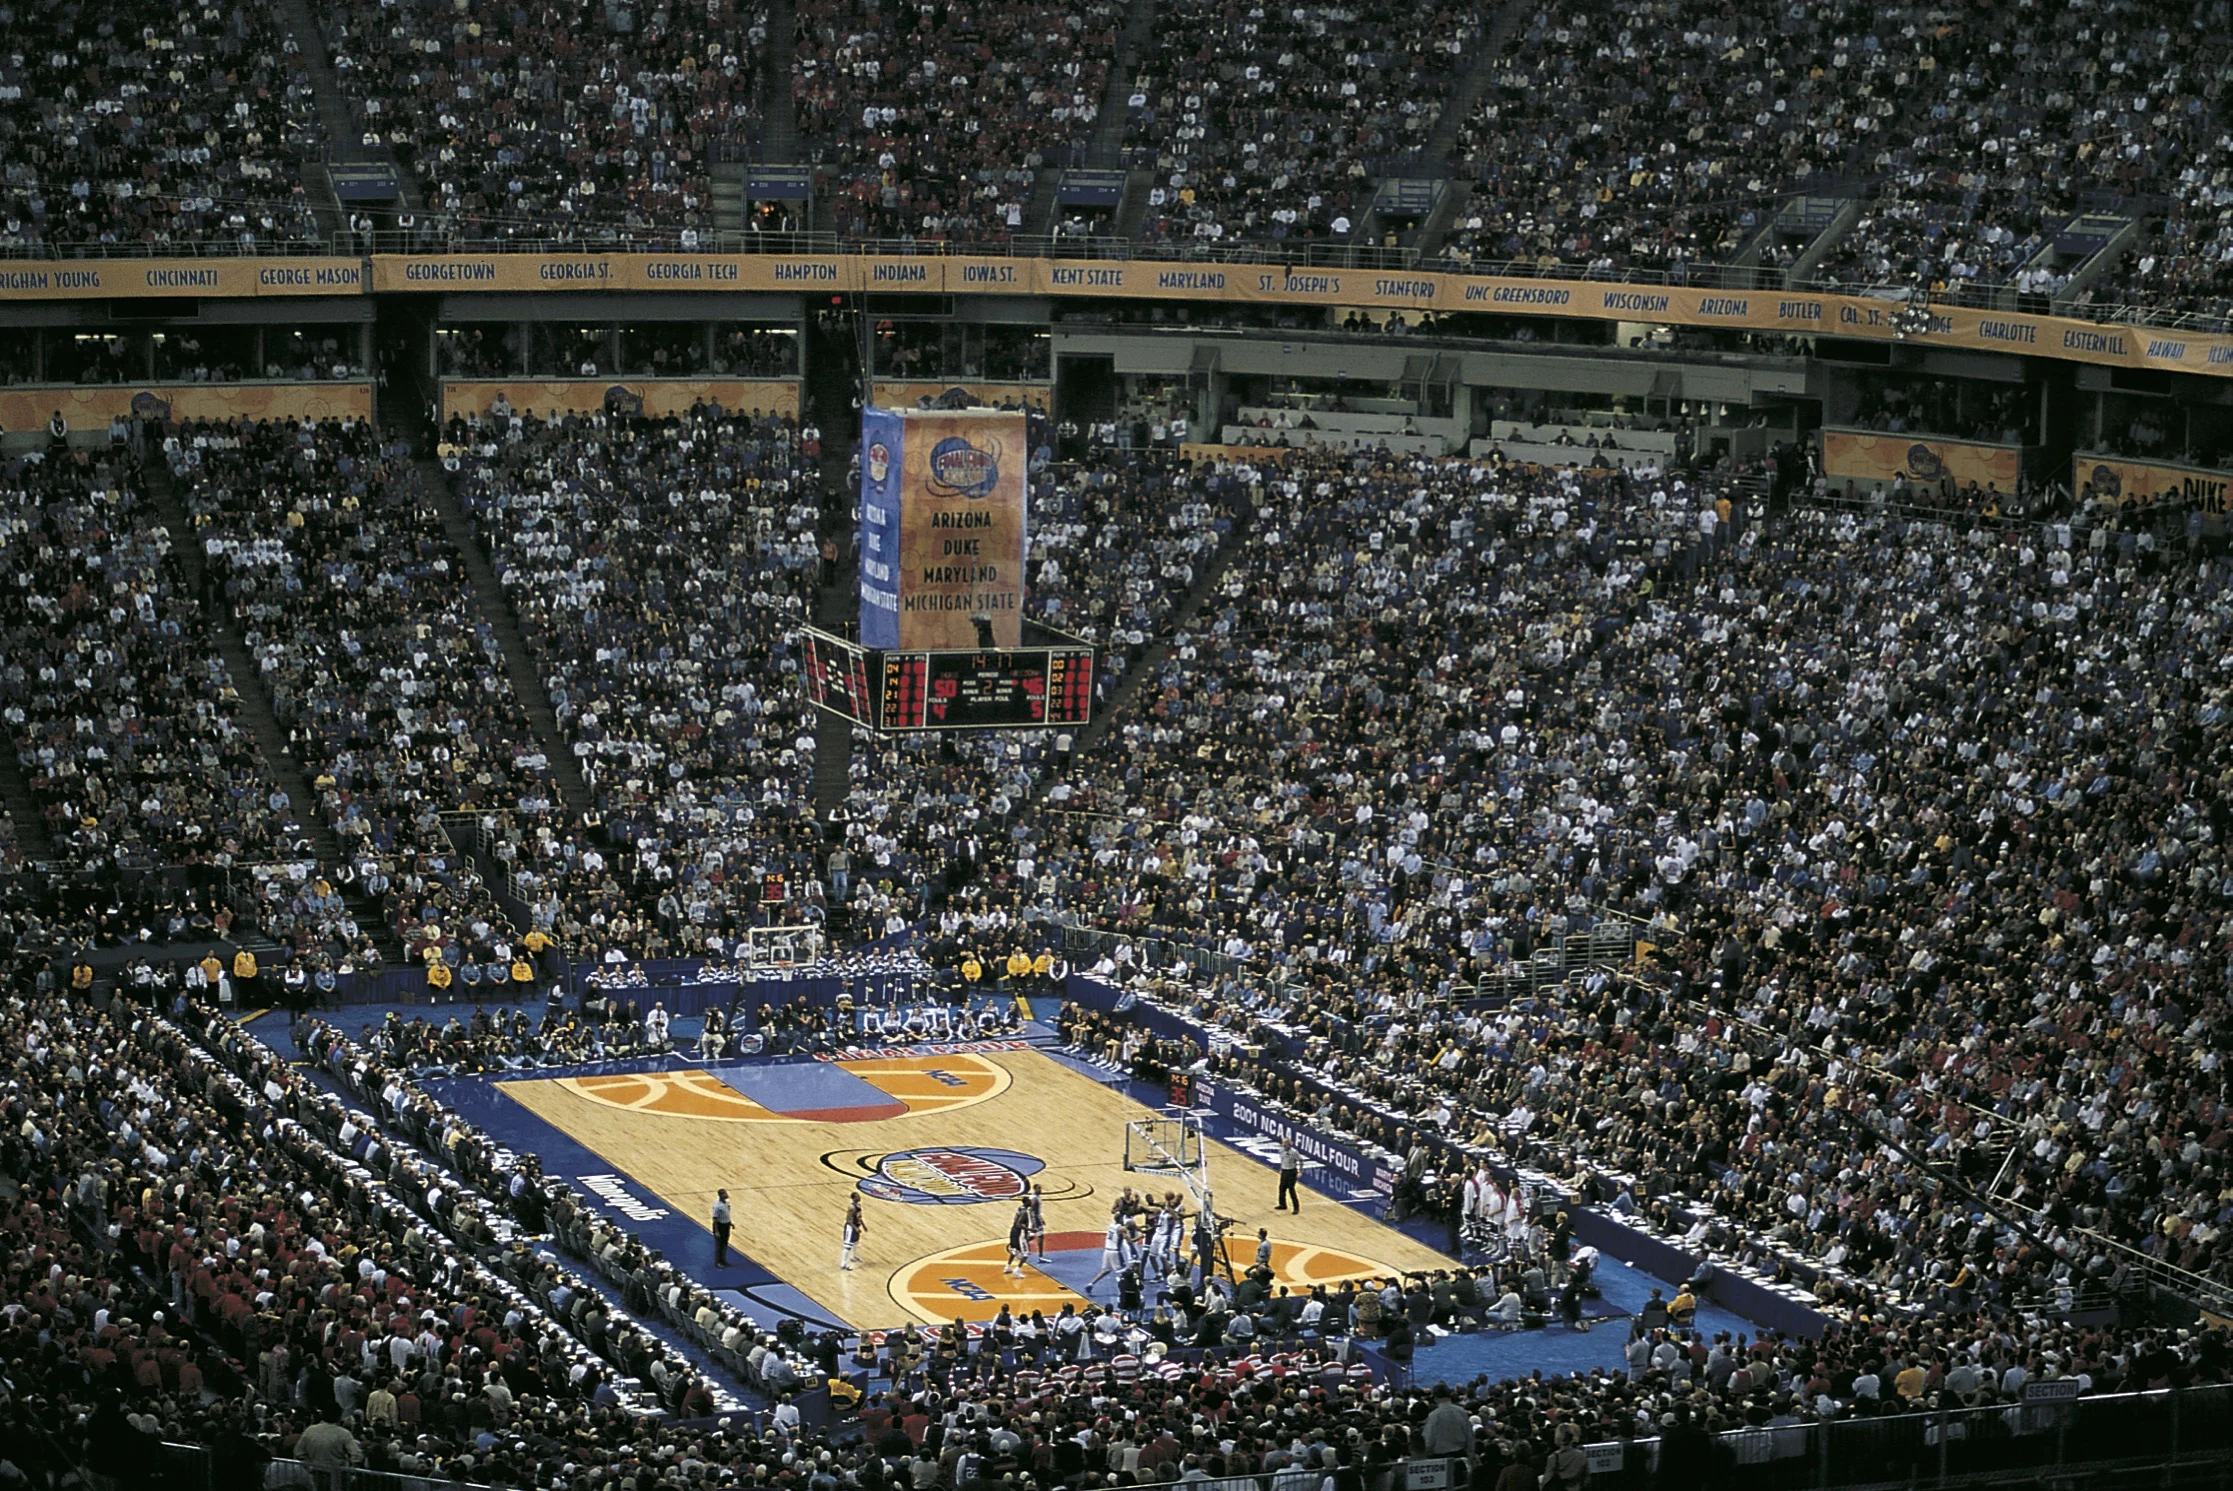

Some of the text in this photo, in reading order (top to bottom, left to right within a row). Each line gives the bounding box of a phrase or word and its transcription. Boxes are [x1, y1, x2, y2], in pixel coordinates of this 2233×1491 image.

[54, 270, 100, 288] YOUNG
[146, 269, 218, 287] CINCINNATI
[260, 268, 361, 286] GEORGE MASON
[405, 263, 495, 280] GEORGETOWN
[540, 262, 614, 280] GEORGIA ST.
[647, 263, 738, 280] GEORGIA TECH
[775, 264, 837, 280] HAMPTON
[873, 264, 927, 281] INDIANA
[963, 265, 1017, 283] IOWA ST.
[1052, 267, 1123, 287] KENT STATE
[1159, 271, 1225, 289] MARYLAND
[1258, 275, 1275, 291] ST.
[1375, 279, 1436, 298] STANFORD
[1465, 284, 1570, 305] UNC GREENSBORO
[1603, 291, 1669, 312] WISCONSIN
[1698, 298, 1748, 317] ARIZONA
[1779, 301, 1822, 320] BUTLER
[1840, 306, 1863, 325] CAL.
[1867, 308, 1883, 326] ST.
[1979, 320, 2037, 343] CHARLOTTE
[2063, 330, 2128, 355] EASTERN ILL.
[2146, 340, 2186, 360] HAWAII
[2183, 476, 2228, 515] DUKE
[931, 511, 992, 529] ARIZONA
[943, 538, 981, 556] DUKE
[924, 566, 997, 584] MARYLAND
[904, 592, 1015, 611] MICHIGAN STATE
[934, 679, 957, 698] 50
[983, 679, 993, 695] 2
[933, 703, 946, 719] 4
[1031, 700, 1043, 718] 5
[927, 1040, 1029, 1056] FOUR
[1233, 1102, 1360, 1178] 2001 NCAA FINAL FOUR
[576, 1174, 670, 1221] Minneapolis
[938, 1278, 996, 1301] NCAA
[2027, 1384, 2075, 1398] SECTION
[1408, 1464, 1446, 1474] SECTION
